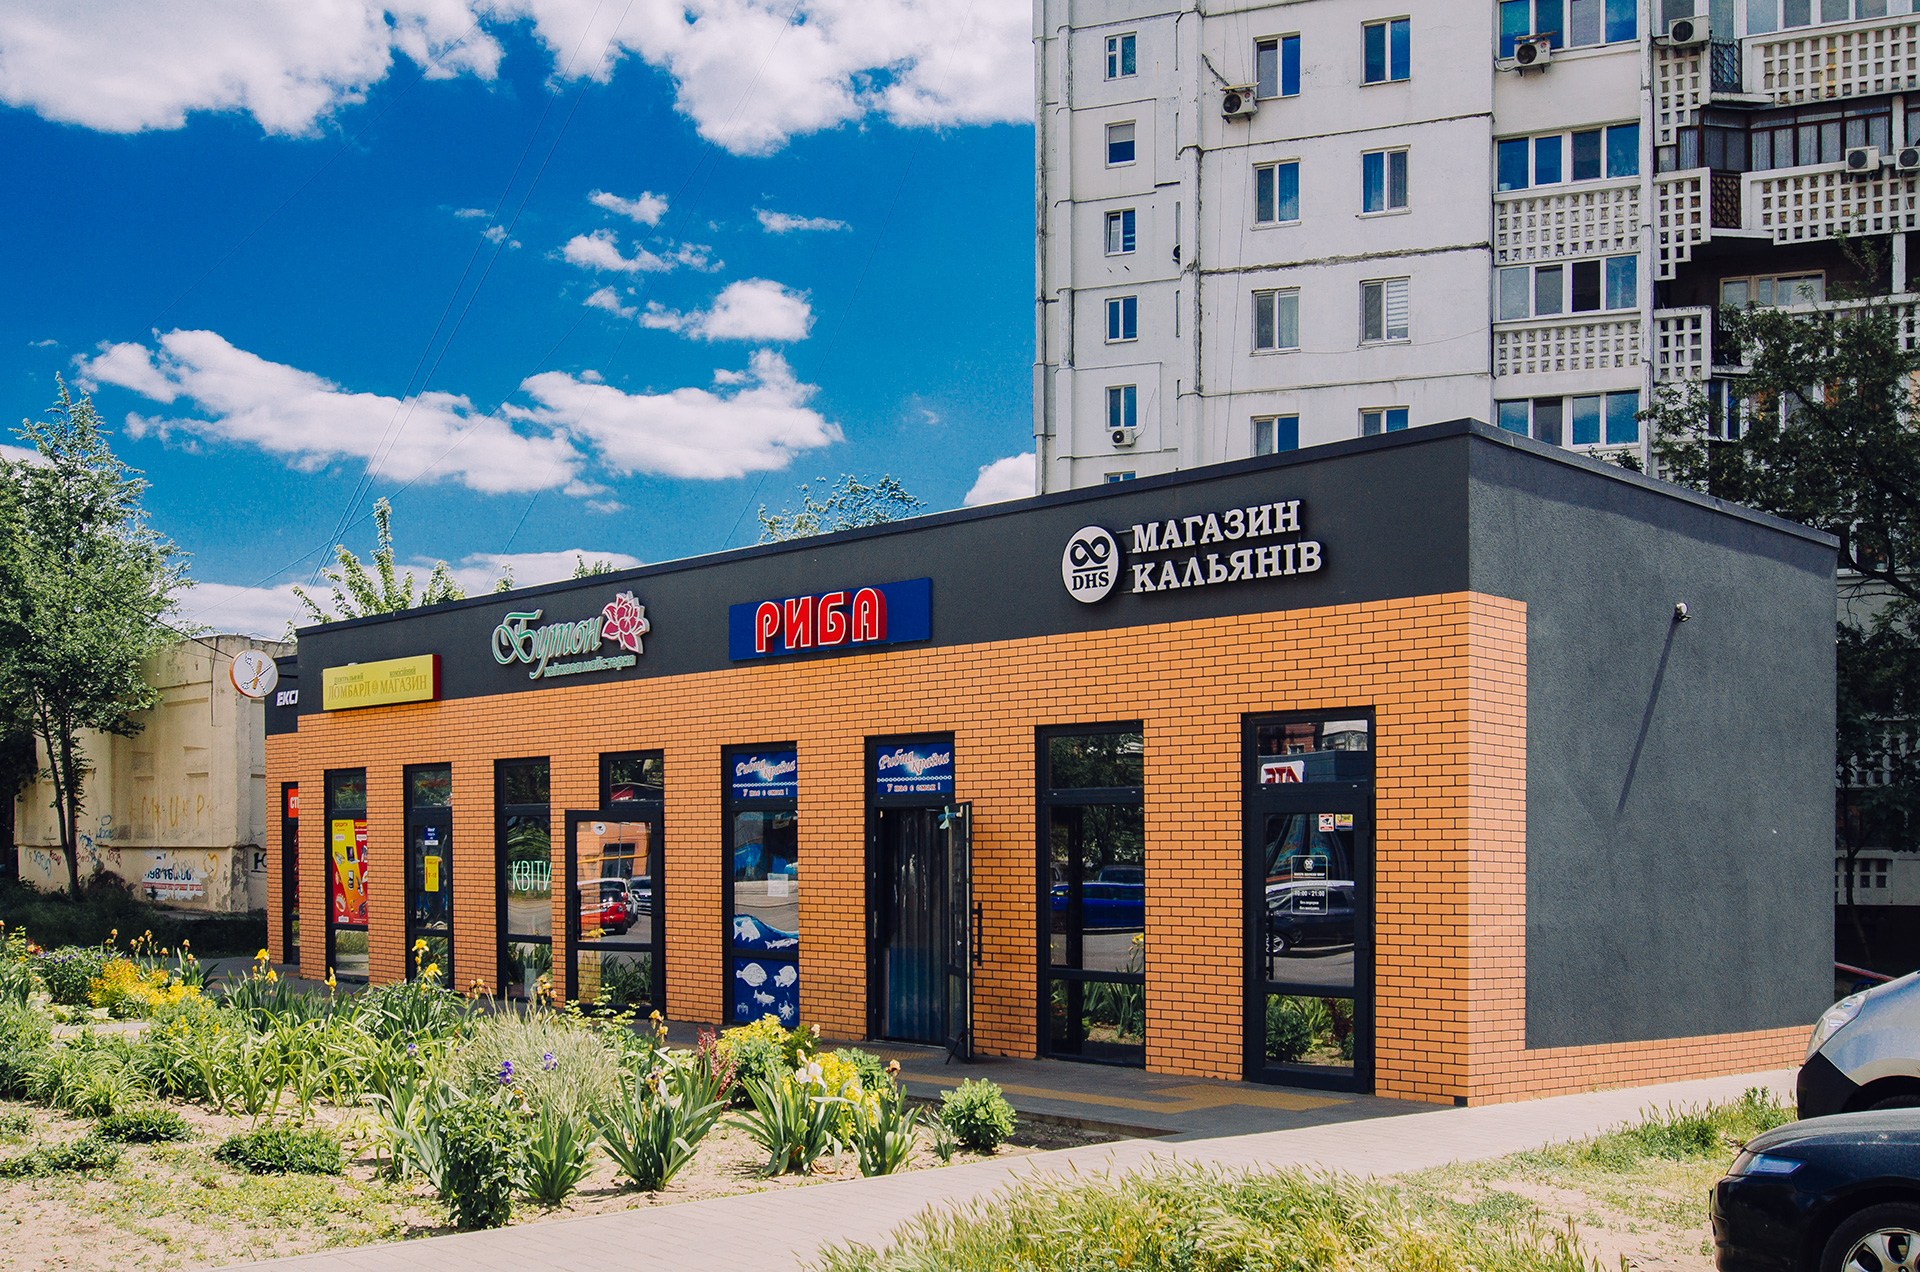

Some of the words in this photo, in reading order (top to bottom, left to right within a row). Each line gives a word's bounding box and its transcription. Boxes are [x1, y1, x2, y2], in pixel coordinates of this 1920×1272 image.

[1132, 499, 1301, 554] МАГАЗИН
[1071, 571, 1109, 590] DHS
[1132, 540, 1322, 593] КАЛЬЯНІВ
[492, 608, 604, 680] Бутон
[756, 587, 887, 653] РИБА
[328, 681, 371, 700] ЛОМБАРД
[380, 675, 428, 695] МАГАЗИН
[544, 661, 582, 678] квіткова
[582, 654, 636, 673] майстерня
